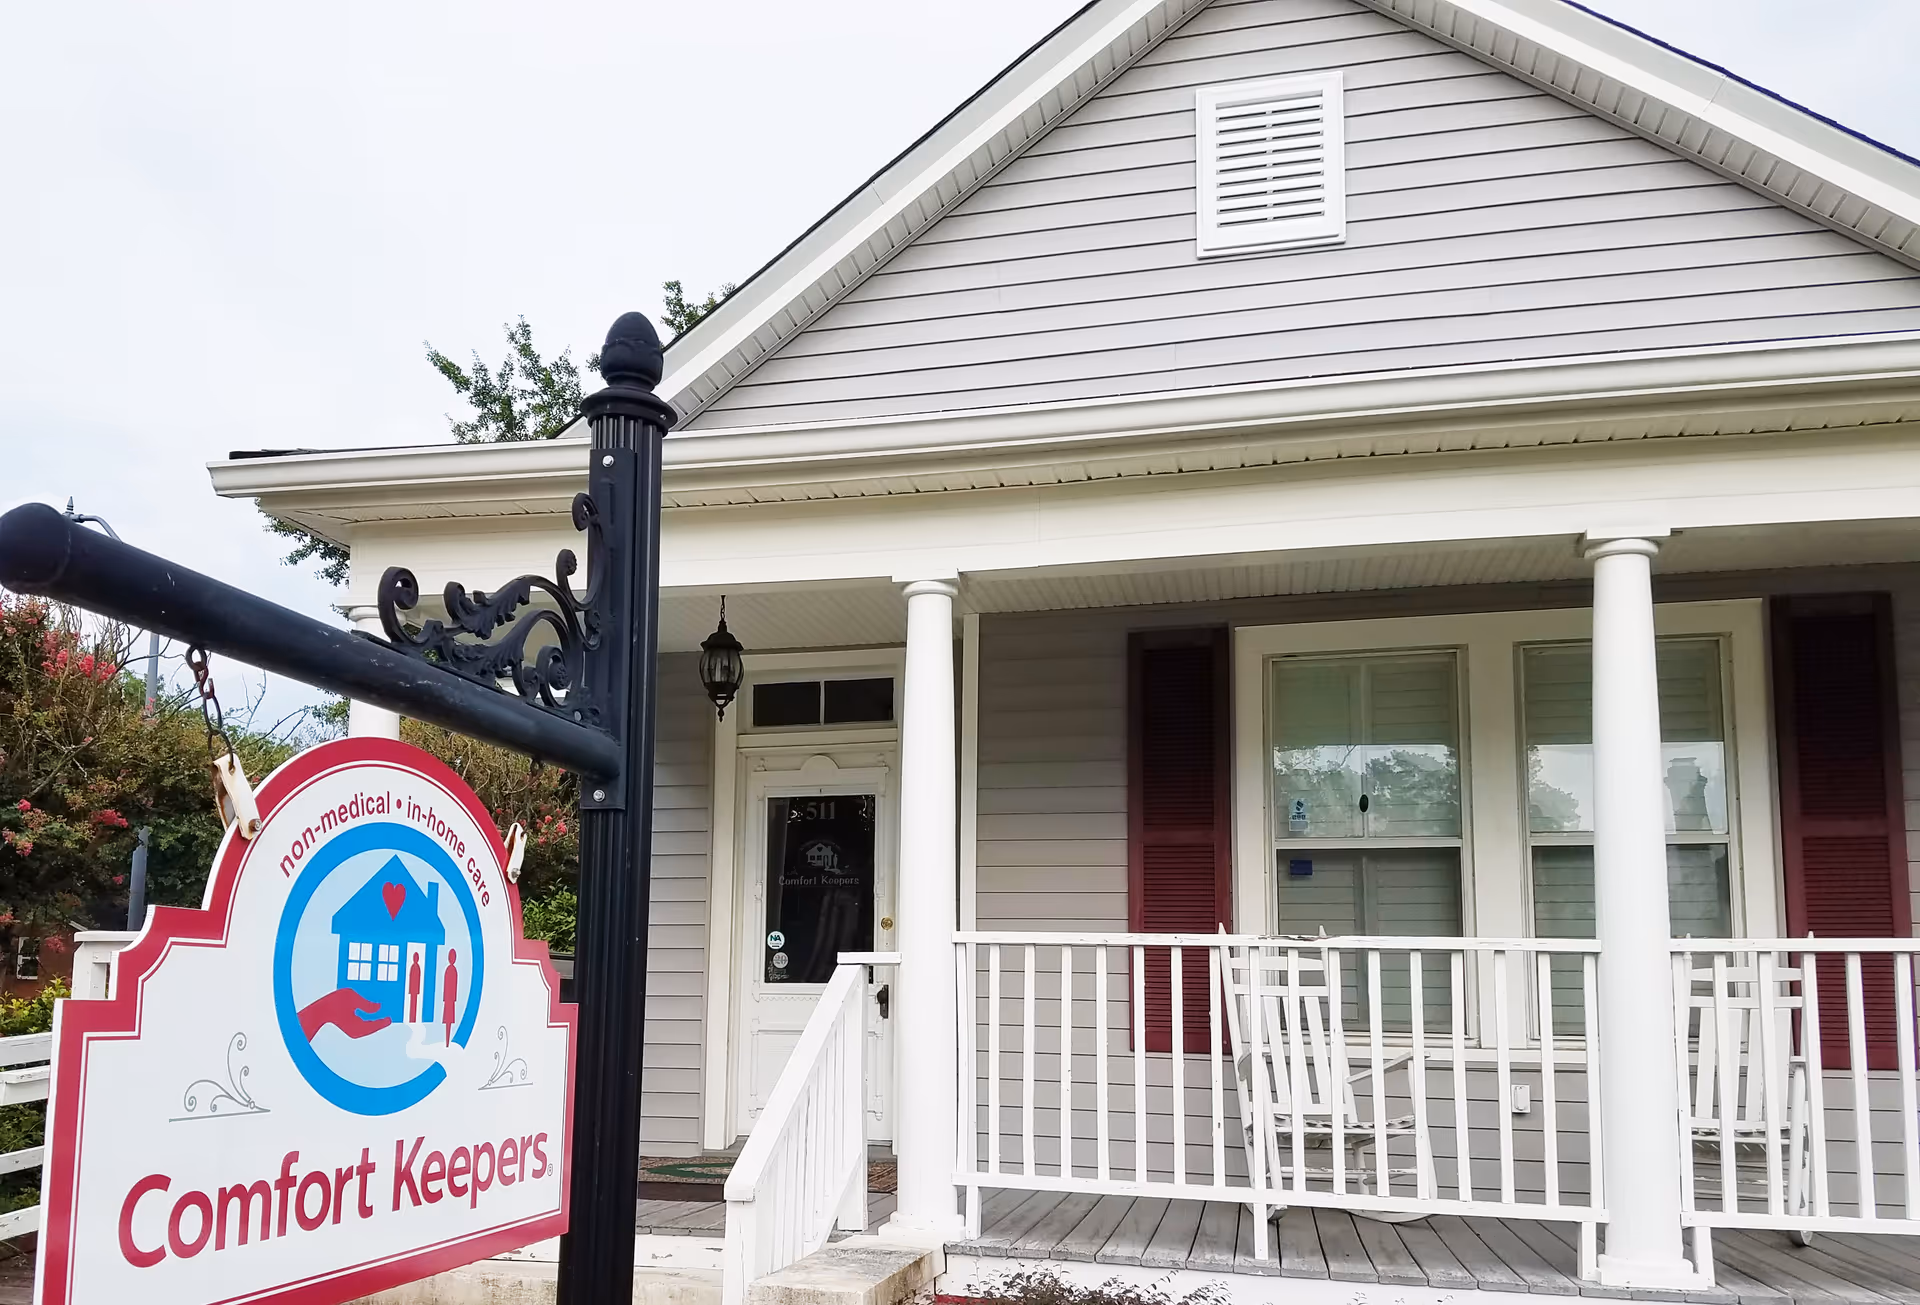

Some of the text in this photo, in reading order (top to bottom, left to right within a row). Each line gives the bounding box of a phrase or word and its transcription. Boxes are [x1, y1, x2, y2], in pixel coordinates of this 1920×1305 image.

[279, 791, 490, 907] non-medical in-home care
[805, 801, 836, 820] 511
[118, 1131, 549, 1269] Comfort Keepers
